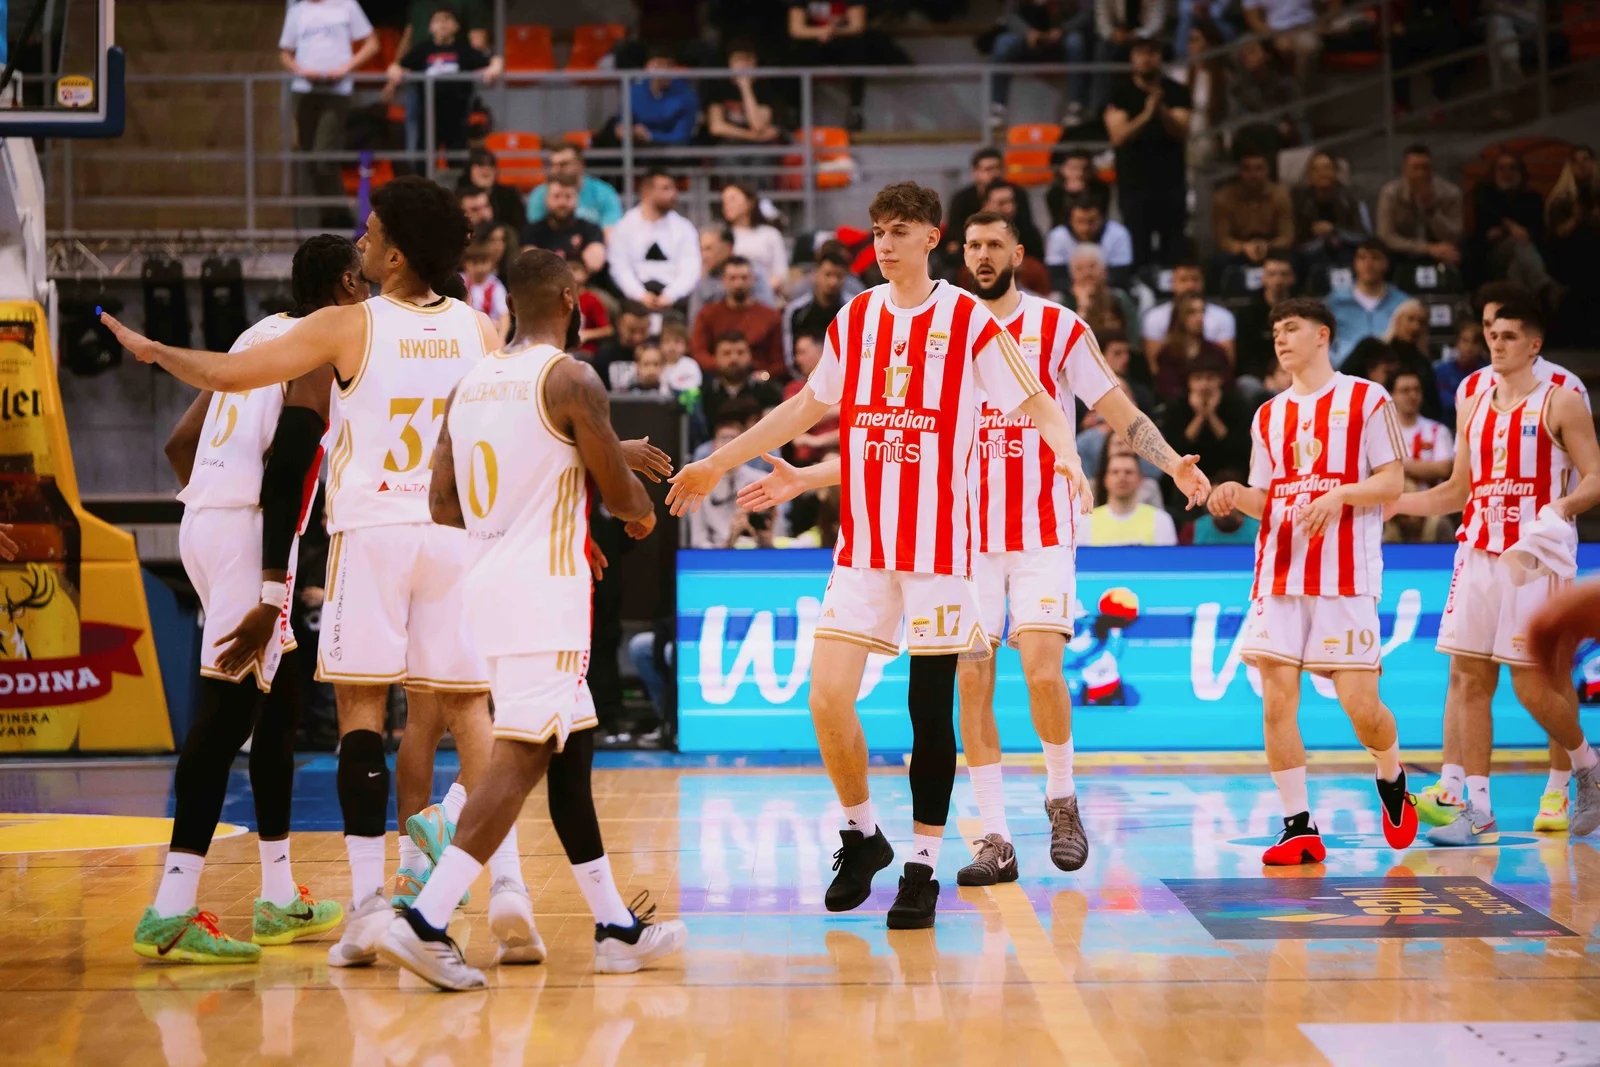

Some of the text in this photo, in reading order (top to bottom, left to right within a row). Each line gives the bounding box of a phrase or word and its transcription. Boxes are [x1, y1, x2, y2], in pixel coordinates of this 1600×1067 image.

[399, 339, 460, 359] NWORA
[882, 366, 913, 399] 17
[855, 408, 936, 431] meridian
[979, 410, 1036, 428] eridian
[863, 436, 921, 463] mts
[1290, 438, 1323, 469] 19
[1493, 447, 1507, 471] 2
[394, 483, 427, 492] ALTA
[468, 440, 498, 519] 0
[1274, 473, 1341, 498] meridian
[1474, 479, 1534, 499] meridian
[1480, 501, 1521, 524] mts
[933, 604, 961, 637] 17
[1345, 629, 1375, 656] 19
